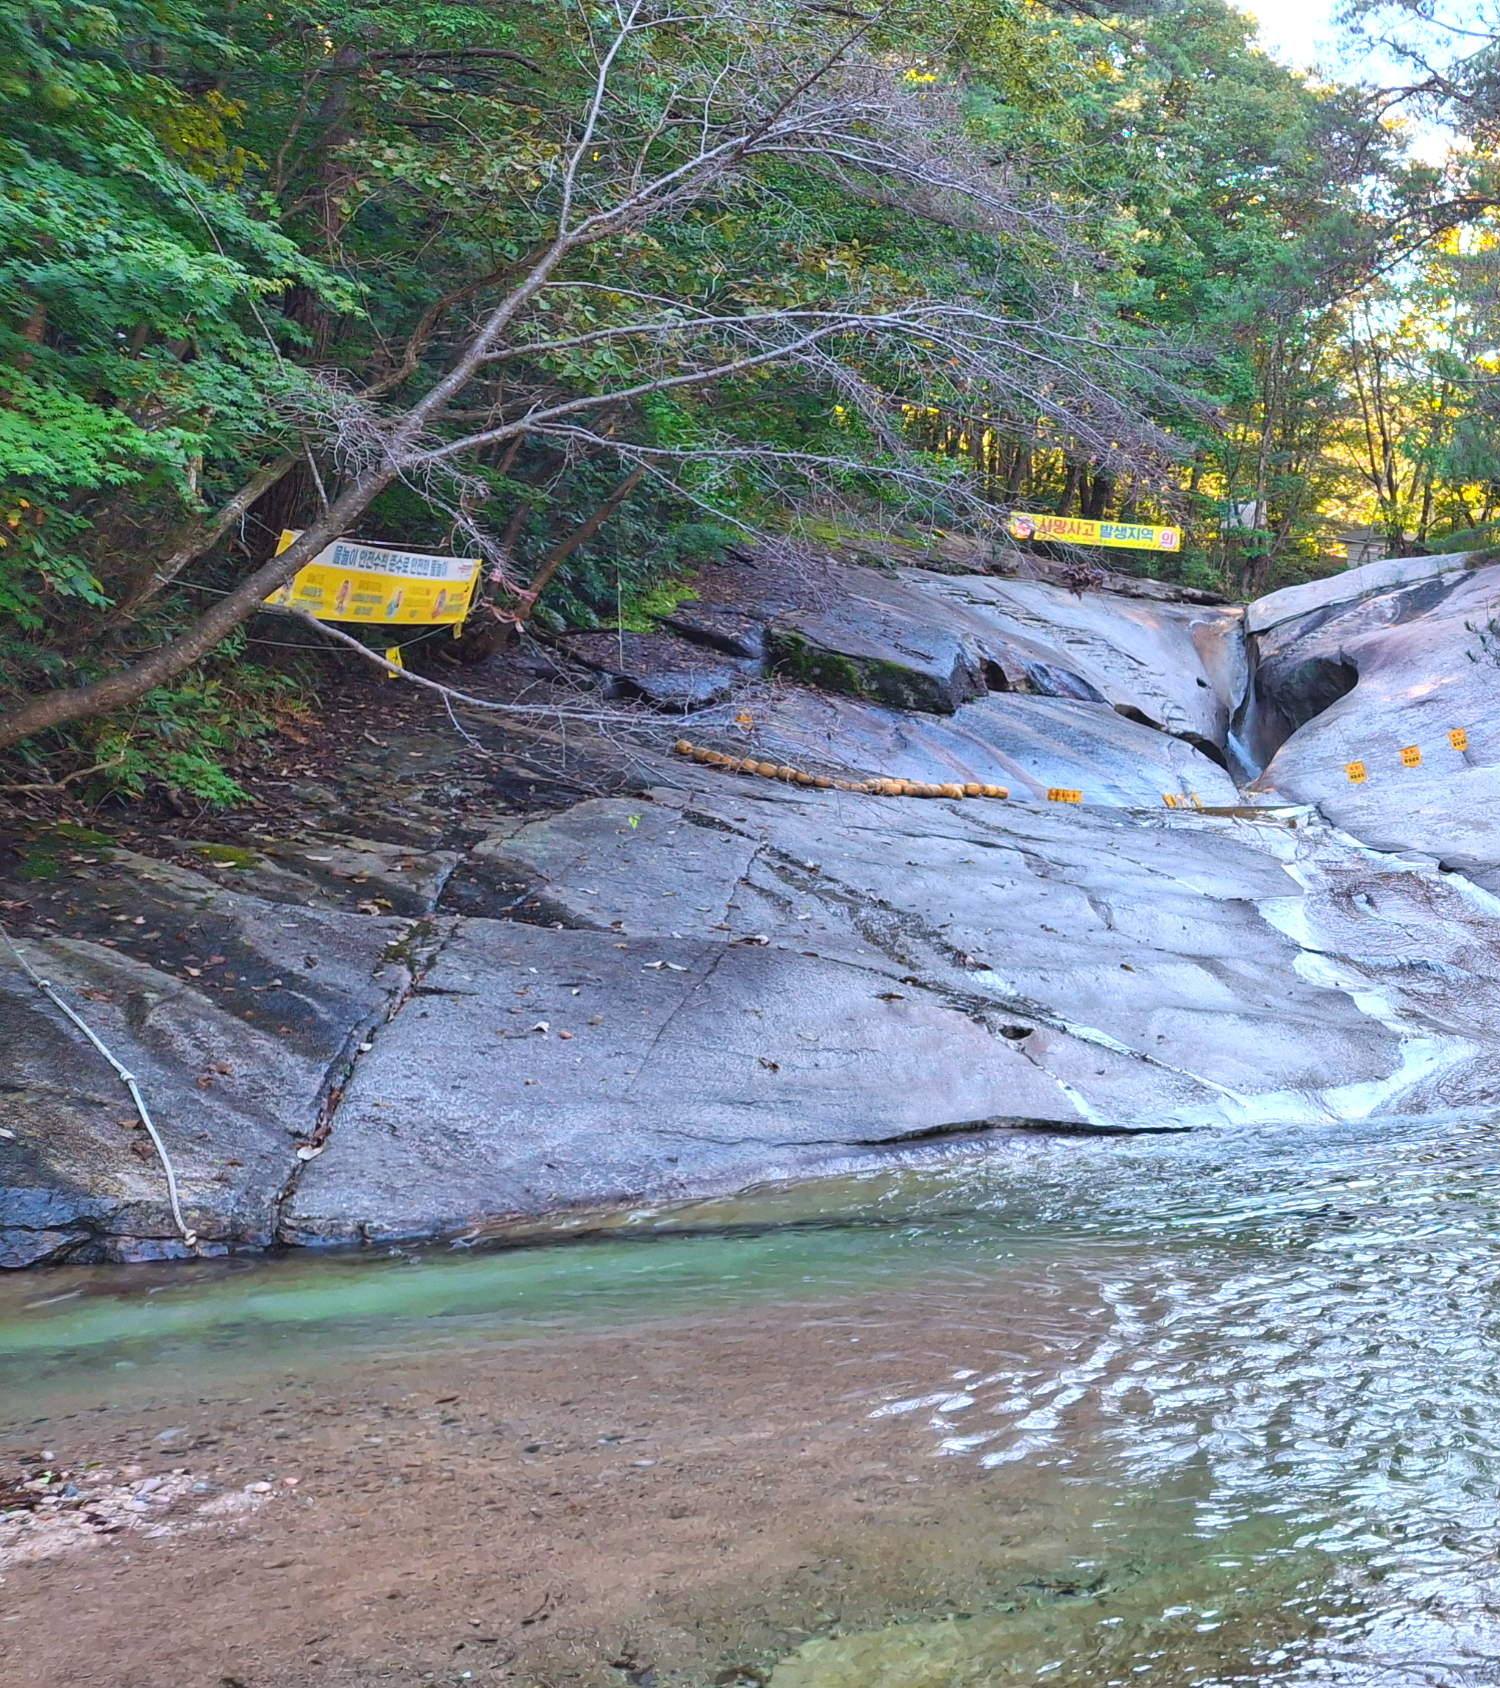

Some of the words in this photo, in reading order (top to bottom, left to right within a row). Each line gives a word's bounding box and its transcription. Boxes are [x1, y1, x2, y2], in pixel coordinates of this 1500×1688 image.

[1038, 518, 1096, 537] 사망사고
[1100, 525, 1154, 542] 발생지역
[1160, 532, 1174, 546] 의
[332, 545, 358, 567] 물놀이
[358, 550, 390, 572] 안전수칙
[389, 554, 411, 574] 준수로
[410, 557, 430, 576] 안전한
[430, 559, 449, 578] 물놀이
